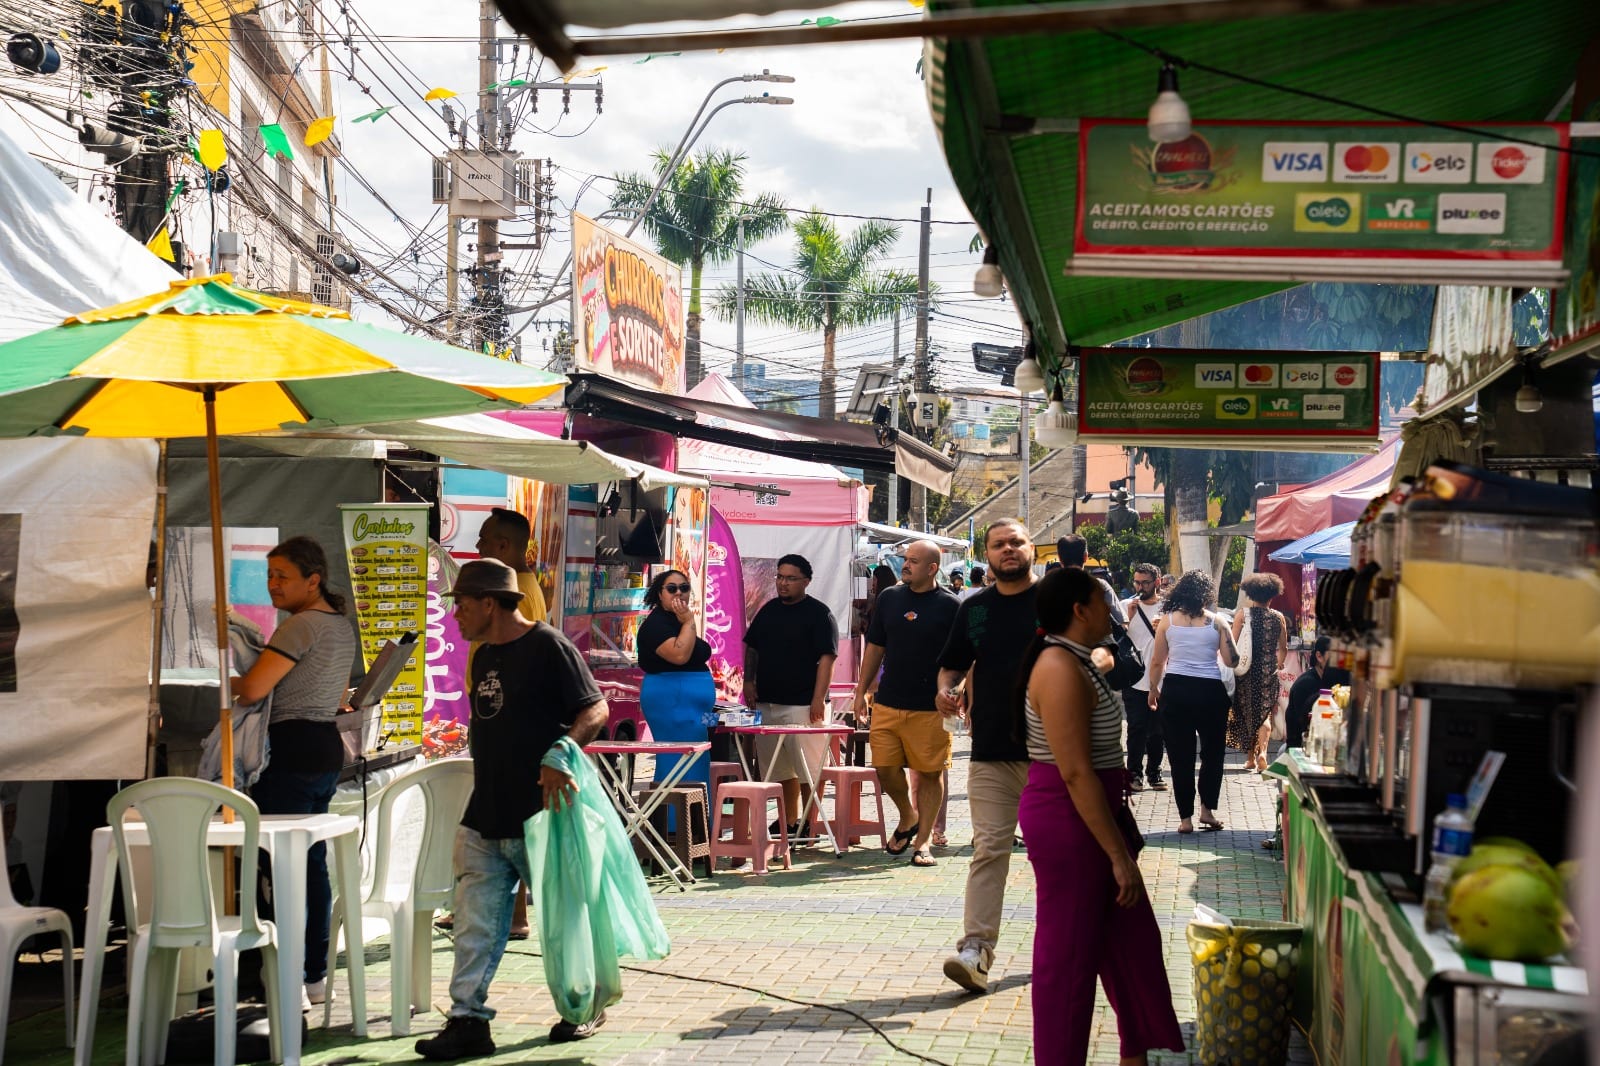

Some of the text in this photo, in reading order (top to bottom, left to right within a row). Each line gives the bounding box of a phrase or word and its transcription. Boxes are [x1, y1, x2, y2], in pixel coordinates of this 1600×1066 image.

[1271, 152, 1323, 171] VISA
[1089, 202, 1274, 218] ACEITAMOS CARTÕES
[1309, 206, 1346, 218] alelo
[1442, 209, 1500, 220] pluxee
[1142, 219, 1196, 231] CRÉDITO
[1197, 222, 1206, 230] E
[1206, 220, 1269, 233] REFEIÇÃO
[604, 243, 664, 329] CHURROS
[611, 316, 664, 377] E SORVETE
[1201, 370, 1232, 381] VISA
[1088, 400, 1204, 411] ACEITAMOS CARTÕES
[1160, 412, 1200, 420] REFEIÇÃO
[353, 513, 415, 541] Carlinhos
